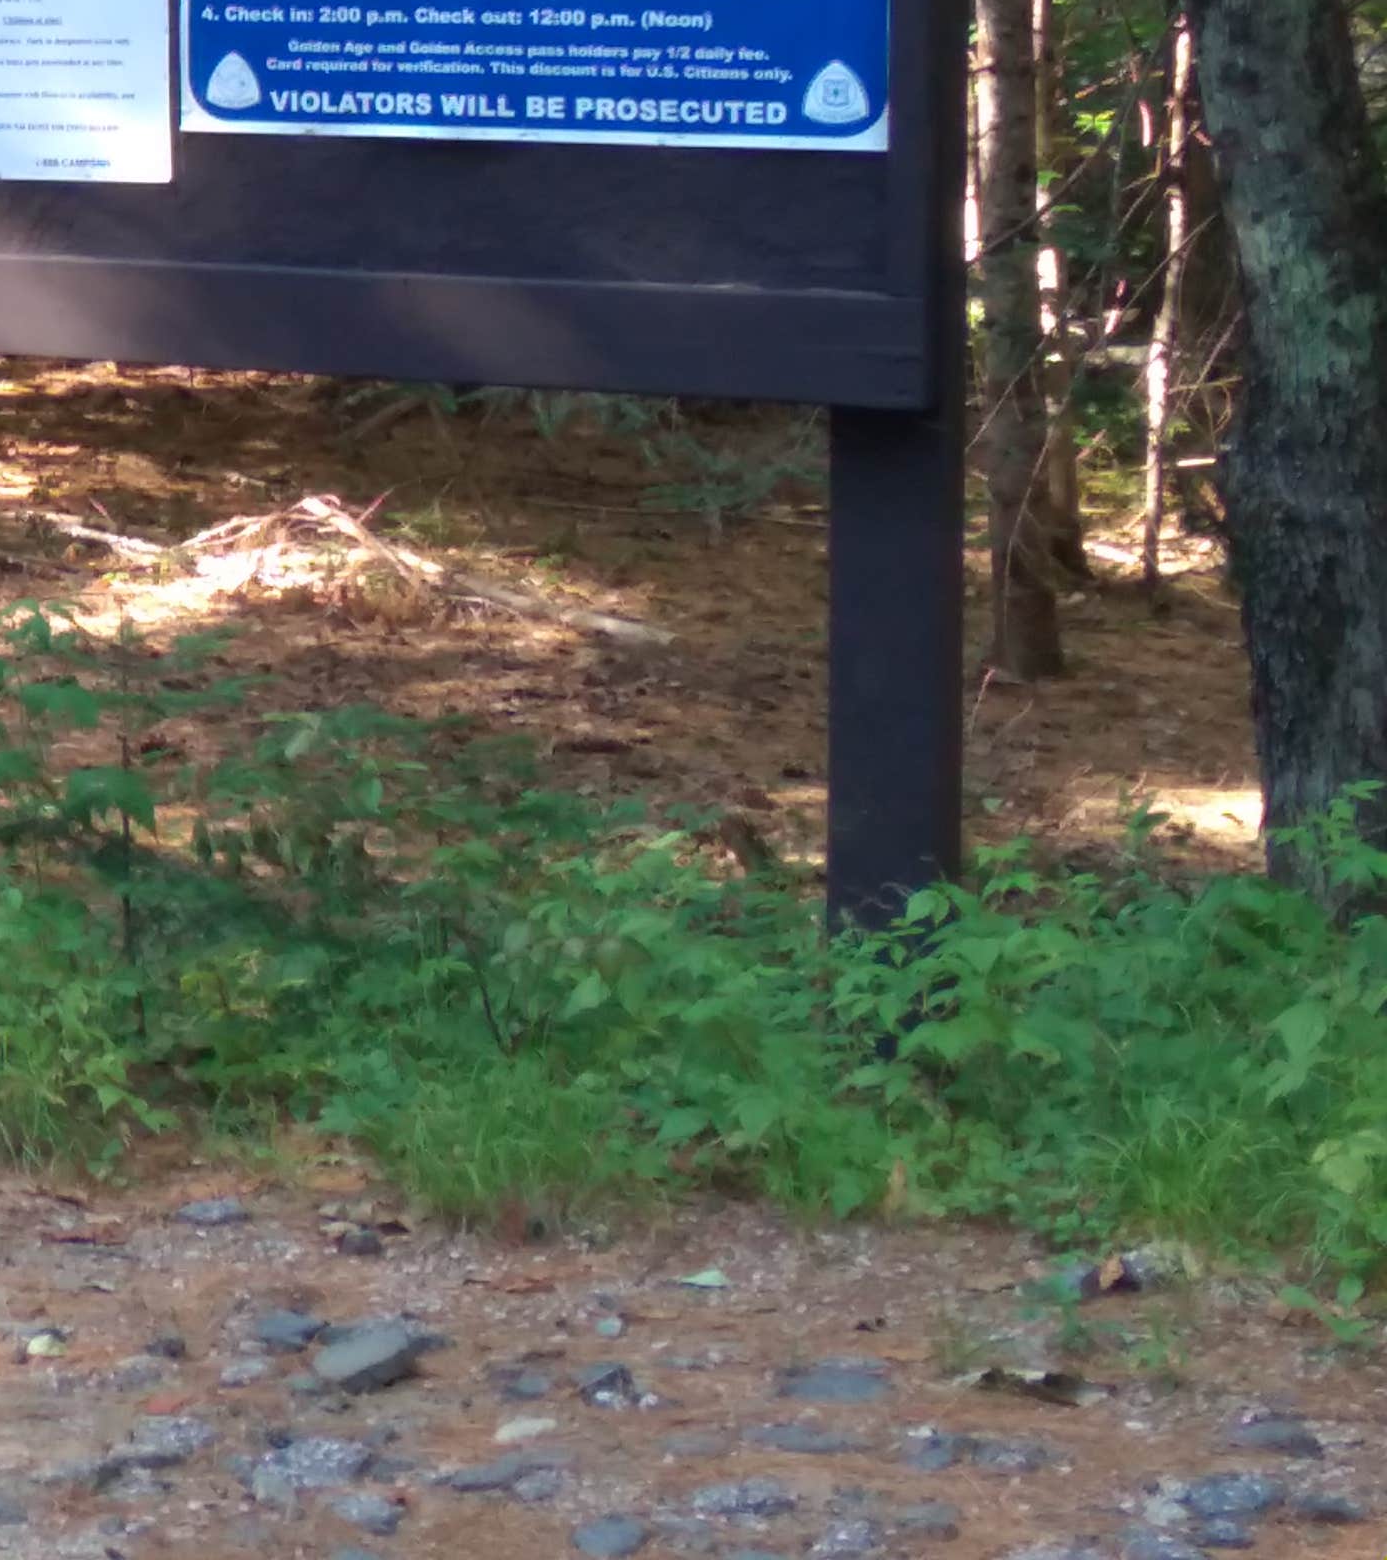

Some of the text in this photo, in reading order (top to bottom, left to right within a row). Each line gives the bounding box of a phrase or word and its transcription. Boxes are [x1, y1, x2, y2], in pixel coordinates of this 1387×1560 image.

[224, 8, 712, 31] Check in: 2:00 p.m. Check out: 12:00 p.m. (Noon)
[269, 91, 786, 124] VIOLATORS WILL BE PROSECUTED
